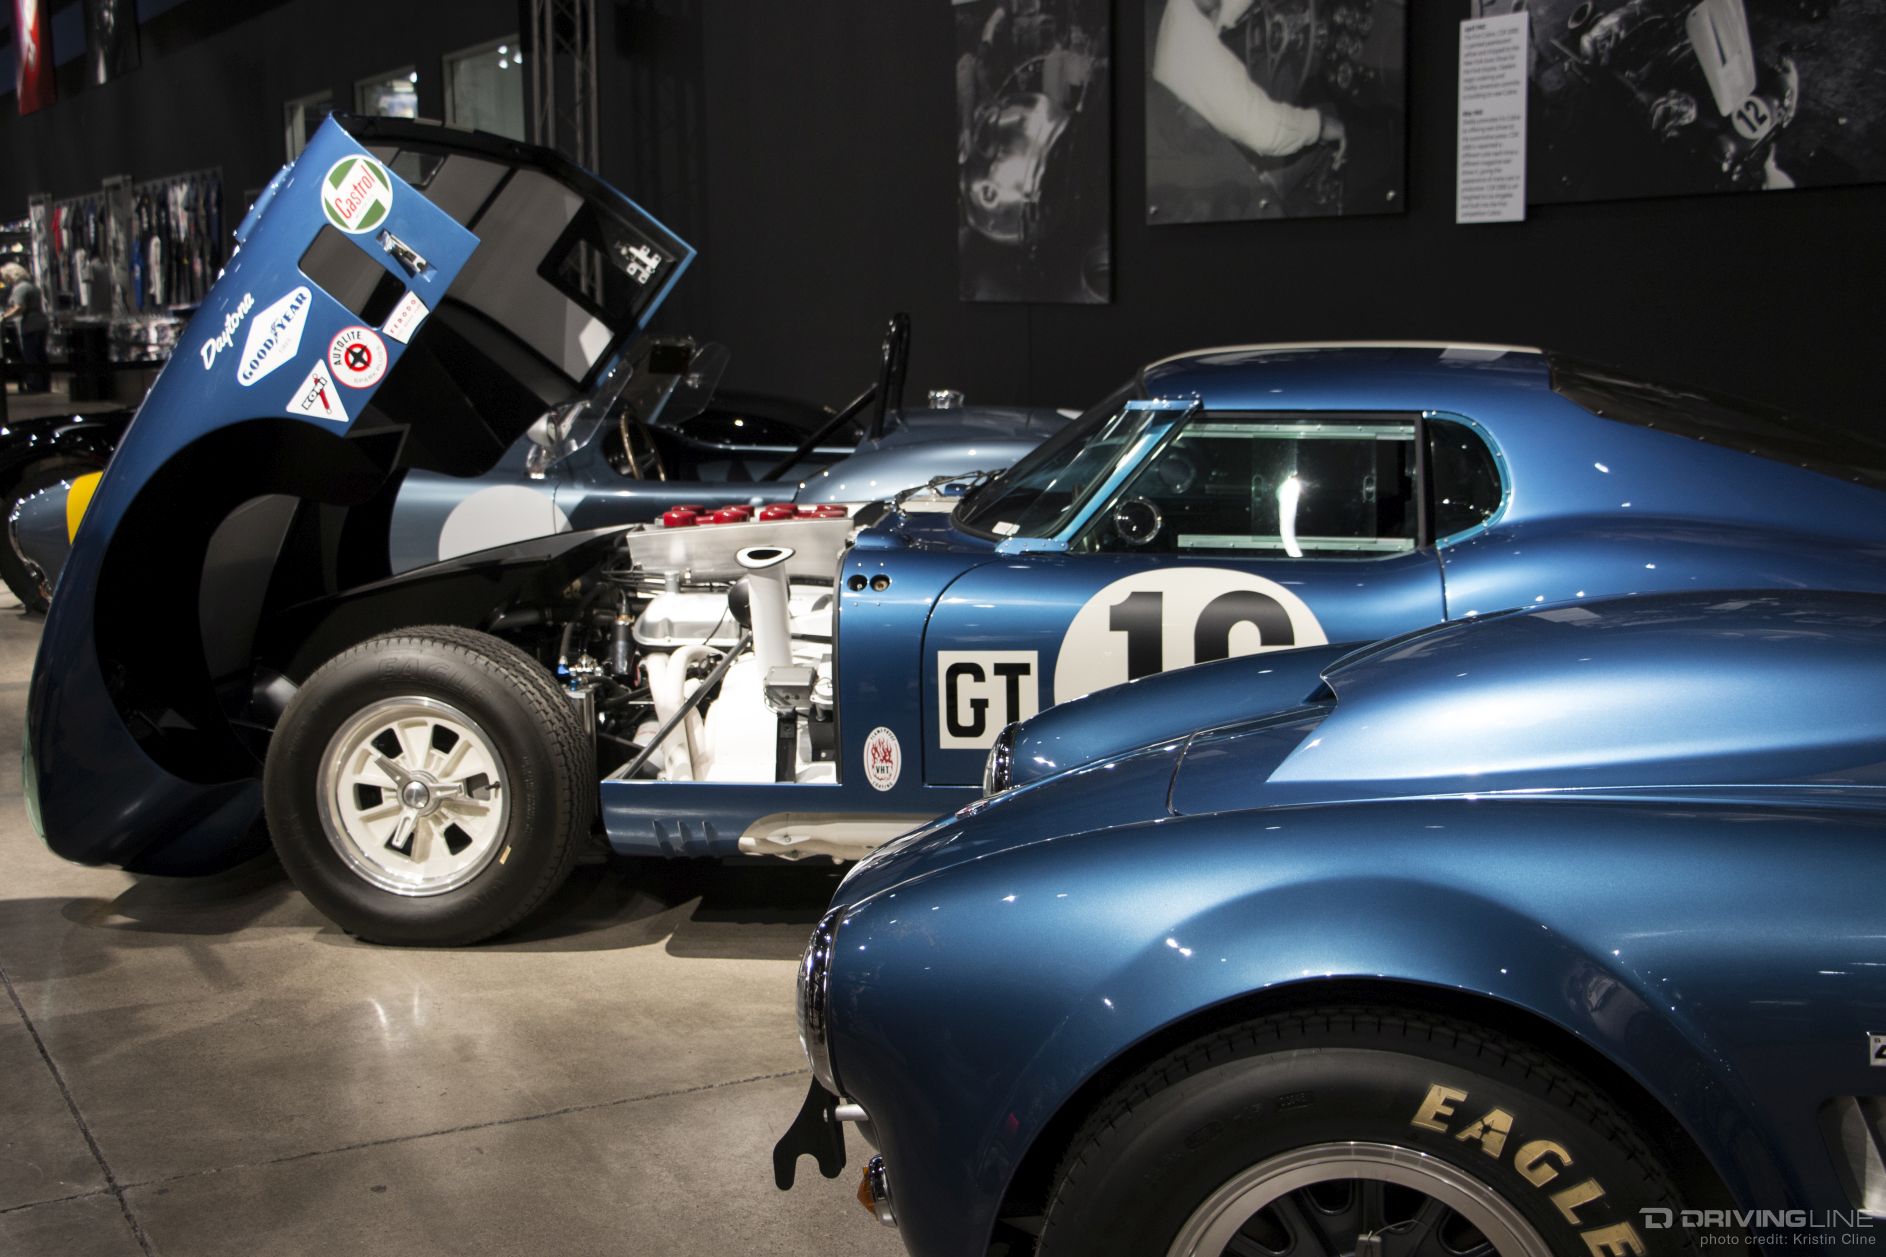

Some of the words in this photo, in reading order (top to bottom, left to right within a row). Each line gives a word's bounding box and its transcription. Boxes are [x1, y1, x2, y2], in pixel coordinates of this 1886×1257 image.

[1737, 101, 1767, 133] 12
[334, 164, 376, 220] Castrol
[200, 292, 255, 370] Daytona
[242, 292, 307, 380] GOODYEAR
[333, 330, 361, 366] AUTOLITE
[301, 376, 328, 411] KONI
[946, 662, 1031, 738] GT
[875, 765, 889, 774] VHT
[1410, 1083, 1645, 1257] EAGLE
